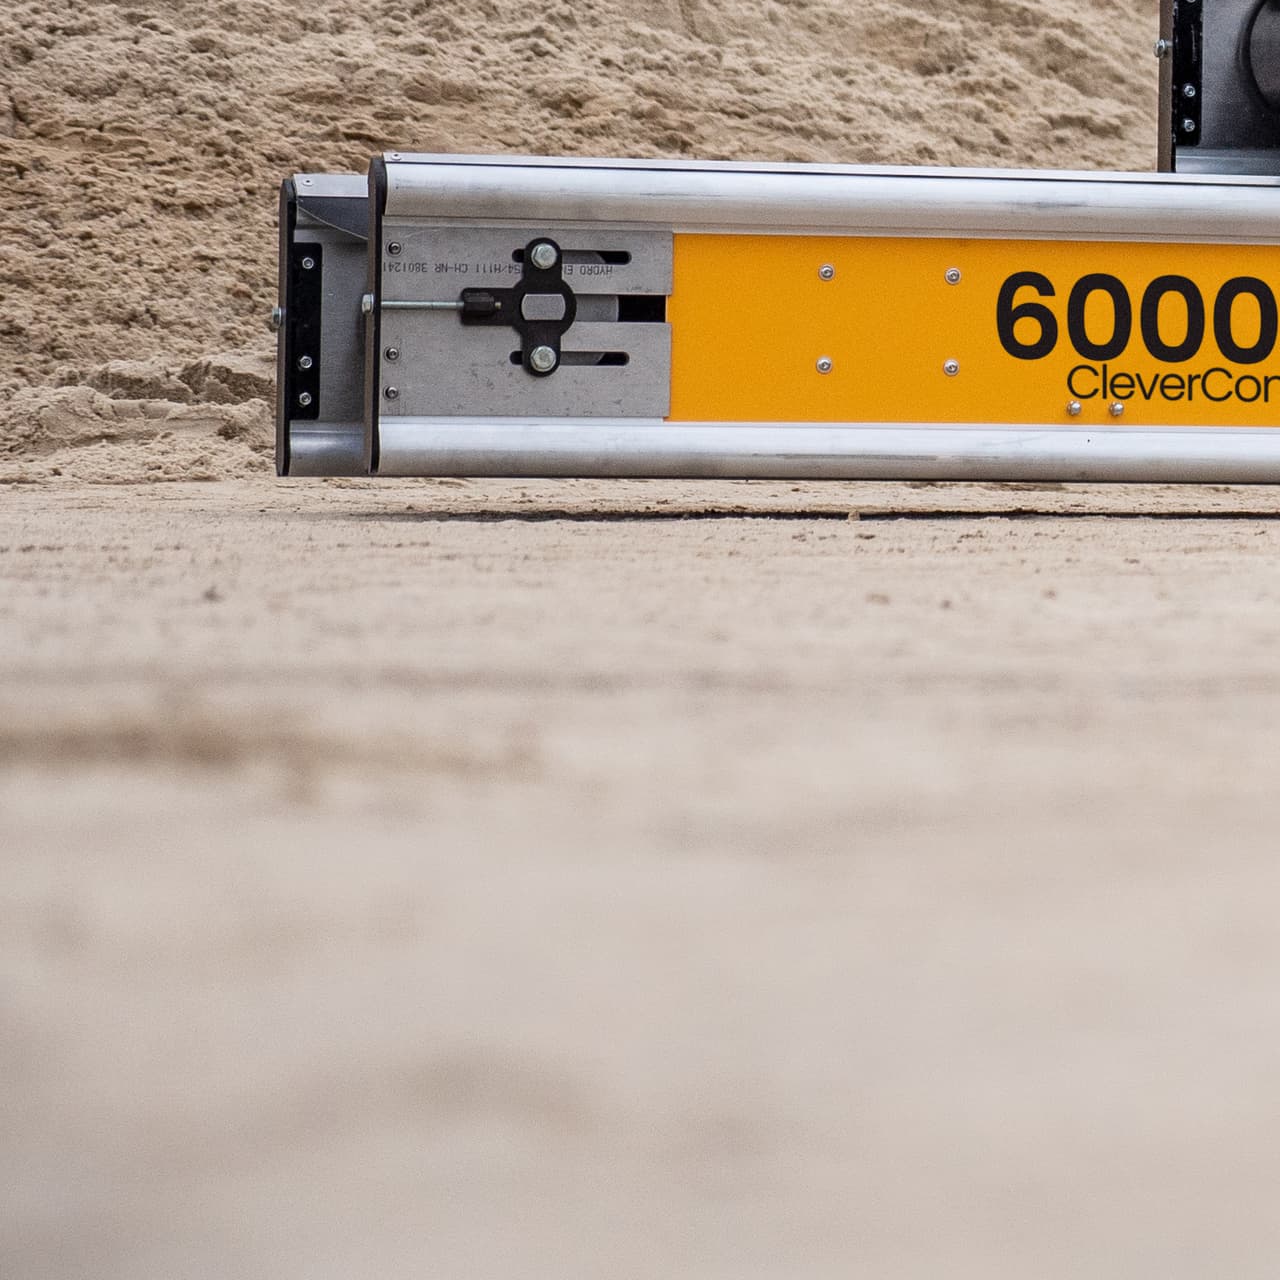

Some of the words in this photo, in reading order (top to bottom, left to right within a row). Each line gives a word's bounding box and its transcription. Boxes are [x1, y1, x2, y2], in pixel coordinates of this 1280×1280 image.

[434, 262, 469, 274] CH-NR
[580, 265, 613, 276] HYDRO
[996, 271, 1279, 365] 6000
